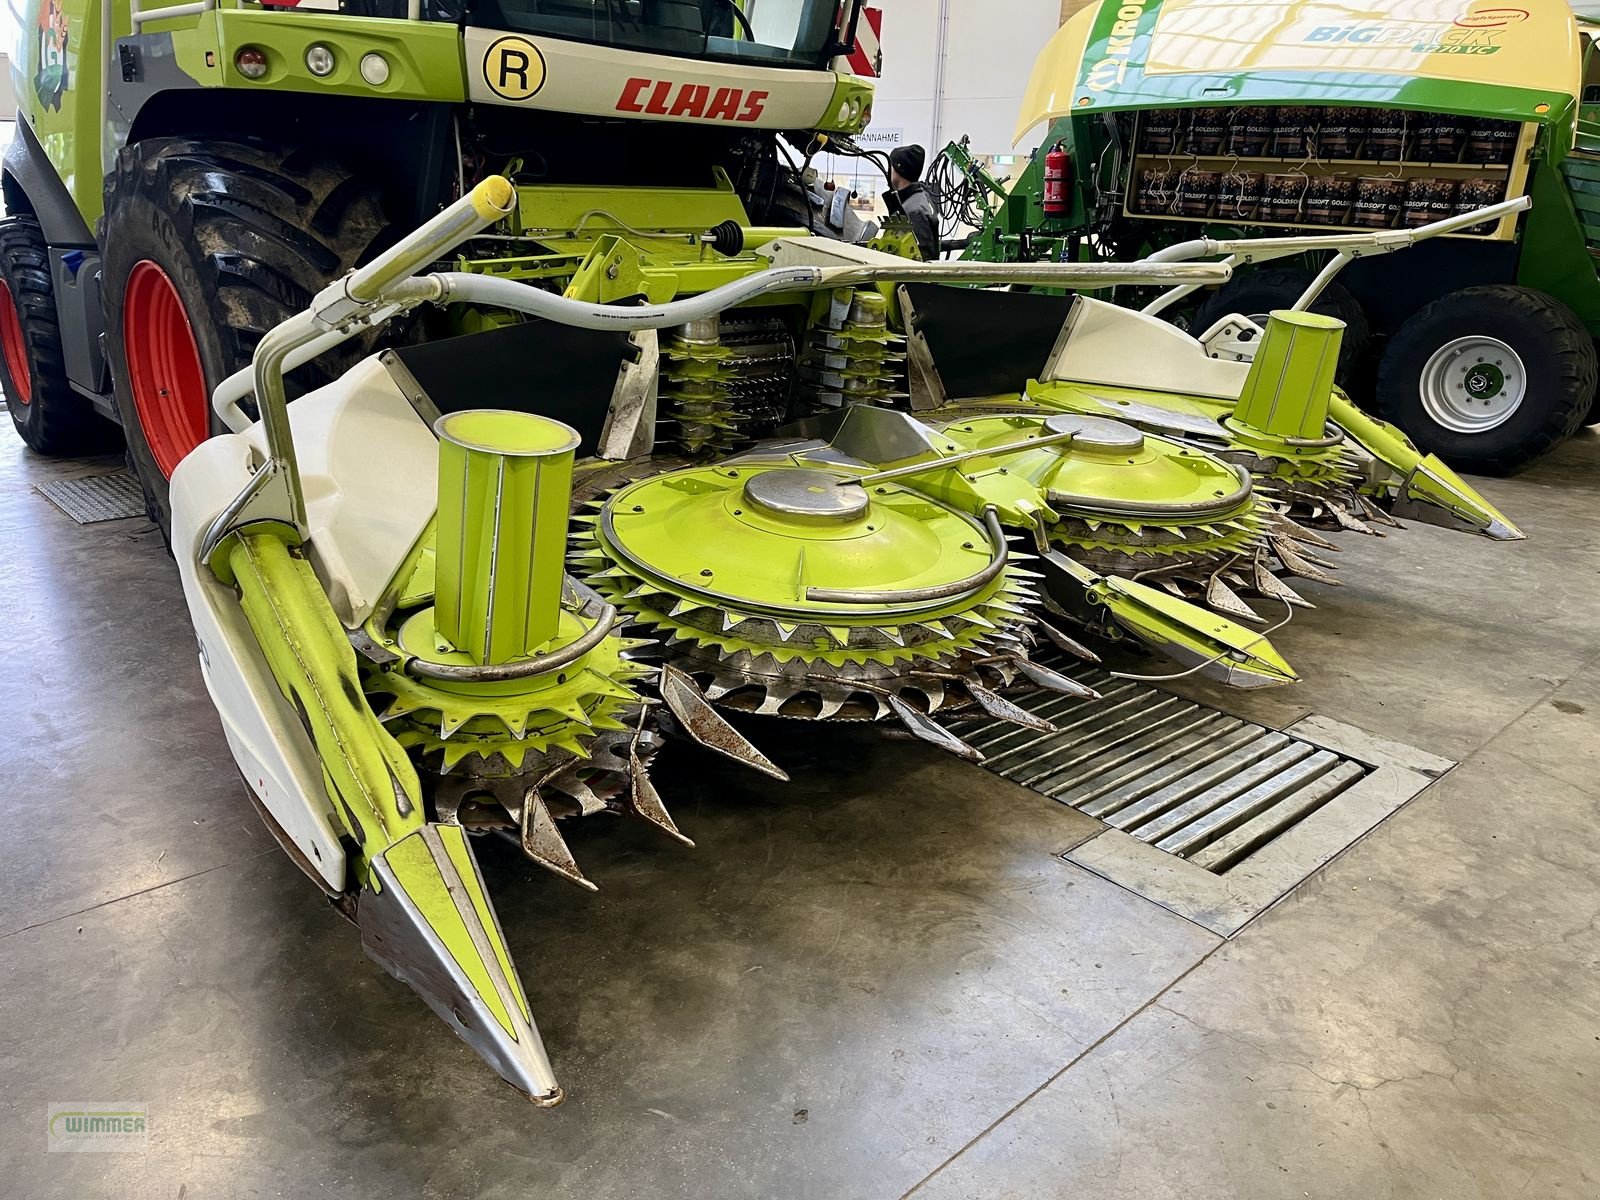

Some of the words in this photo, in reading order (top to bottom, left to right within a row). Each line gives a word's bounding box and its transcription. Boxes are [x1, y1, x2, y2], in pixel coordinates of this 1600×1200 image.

[1106, 0, 1147, 54] KRO
[499, 49, 529, 90] R
[1466, 46, 1493, 55] VC
[615, 78, 769, 121] CLAAS
